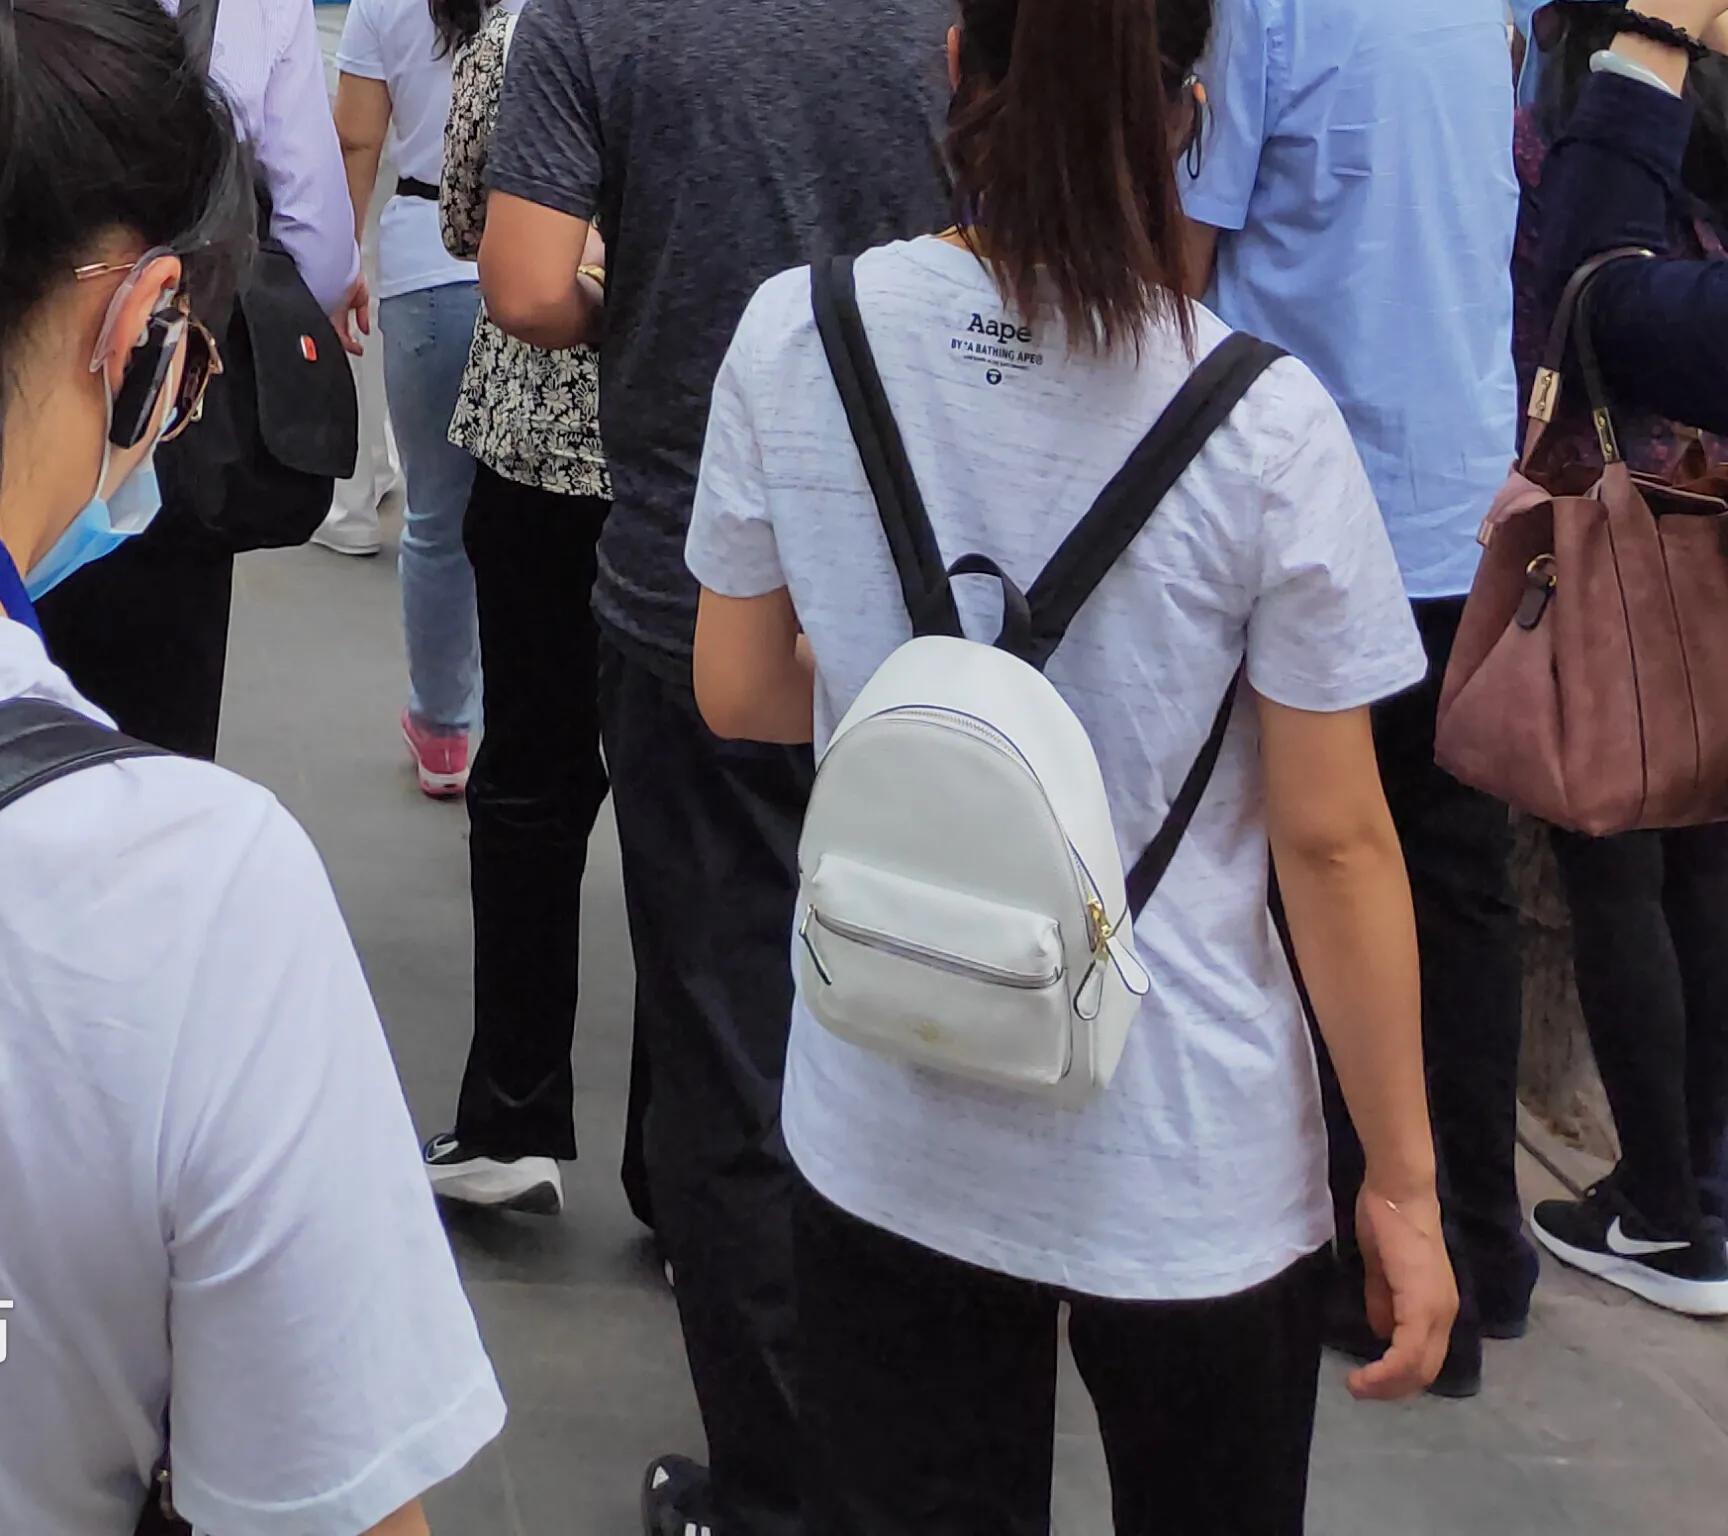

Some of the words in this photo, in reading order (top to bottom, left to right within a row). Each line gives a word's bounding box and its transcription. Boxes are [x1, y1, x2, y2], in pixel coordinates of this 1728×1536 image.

[966, 312, 1033, 344] Aape
[951, 338, 963, 349] BY
[975, 343, 1015, 361] BATHING
